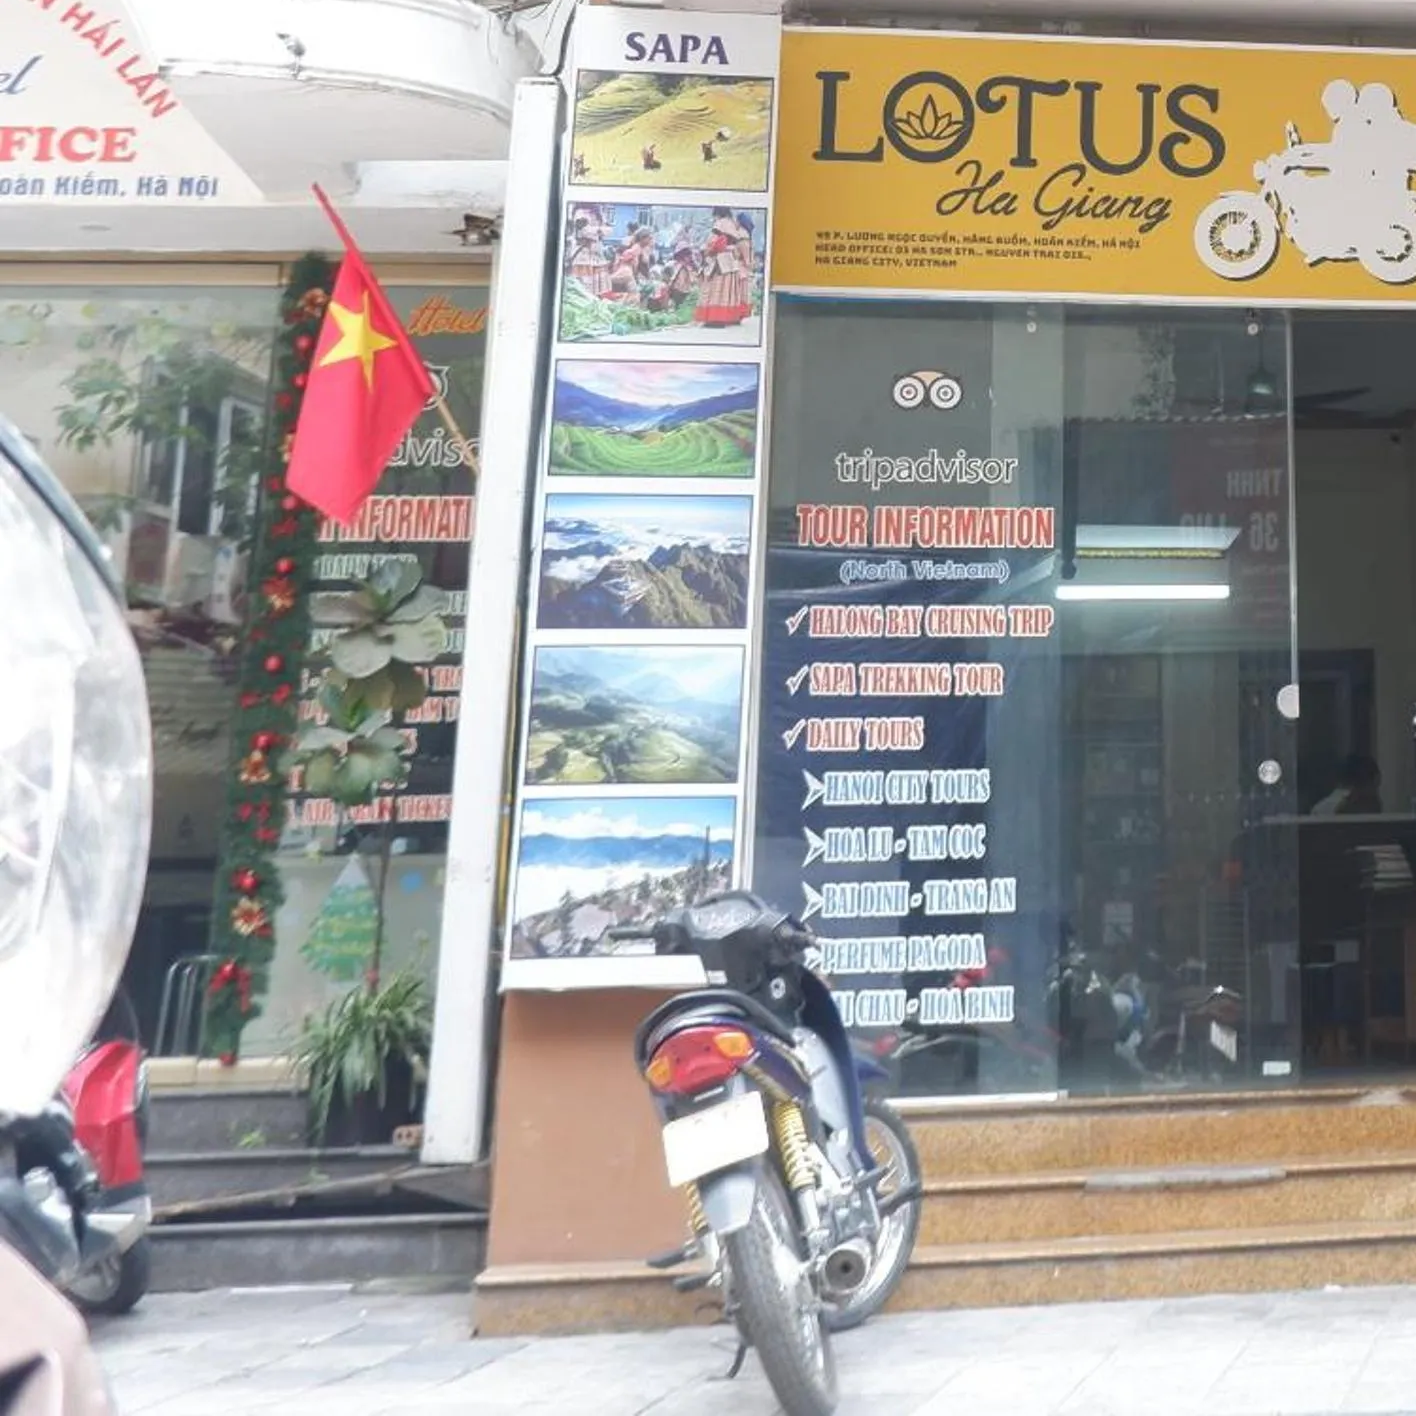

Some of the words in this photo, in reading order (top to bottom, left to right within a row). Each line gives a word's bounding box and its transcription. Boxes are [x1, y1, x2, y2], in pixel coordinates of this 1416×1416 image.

[625, 32, 729, 65] SAPA
[813, 70, 1226, 177] LOTUS
[936, 159, 1018, 220] Ha
[1033, 163, 1172, 234] Giang
[835, 448, 1018, 491] tripadvisor
[796, 504, 869, 547] TOUR
[873, 505, 1055, 548] INFORMATION
[839, 560, 908, 585] (North
[910, 560, 1010, 585] Vietnam)
[809, 605, 883, 637] HALONG
[885, 605, 924, 637] BAY
[926, 605, 1005, 637] CRUISING
[1010, 605, 1054, 636] TRIP
[809, 662, 855, 696] SAPA
[859, 662, 951, 696] TREKKING
[954, 661, 1004, 696] TOUR
[807, 717, 862, 751] DAILY
[865, 717, 924, 751] TOURS
[823, 772, 884, 805] HANOI
[885, 770, 929, 804] CITY
[930, 769, 990, 803] TOURS
[823, 828, 866, 862] HOA
[868, 827, 893, 861] LU
[907, 825, 948, 860] TAM
[950, 824, 985, 859] COC
[821, 884, 859, 918] BAI
[860, 882, 909, 916] DINH
[924, 879, 987, 915] TRANG
[989, 878, 1016, 913] AN
[818, 937, 906, 974] PERFUME
[907, 934, 986, 971] PAGODA
[856, 989, 906, 1026] CHAU
[919, 988, 963, 1024] HOA
[964, 986, 1014, 1023] BINH
